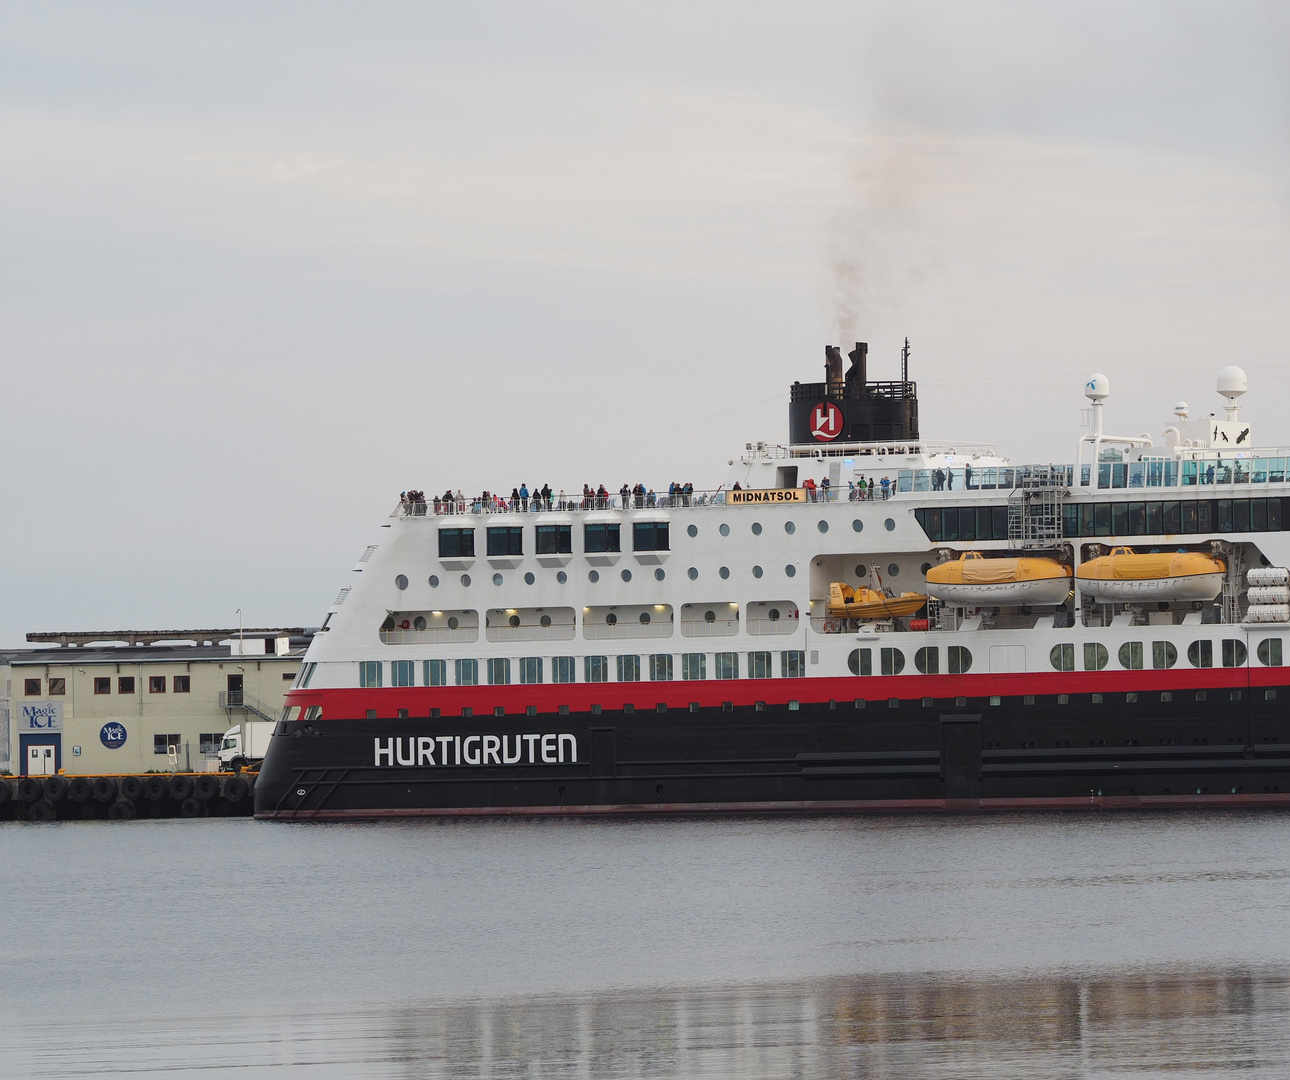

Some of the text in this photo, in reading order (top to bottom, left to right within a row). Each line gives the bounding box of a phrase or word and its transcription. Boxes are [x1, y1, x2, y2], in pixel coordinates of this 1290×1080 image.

[733, 491, 799, 502] MIDNATSOL
[22, 703, 57, 717] Magic
[29, 715, 58, 728] ICE
[107, 732, 124, 740] ICE
[374, 733, 578, 766] HURTIGRUTEN
